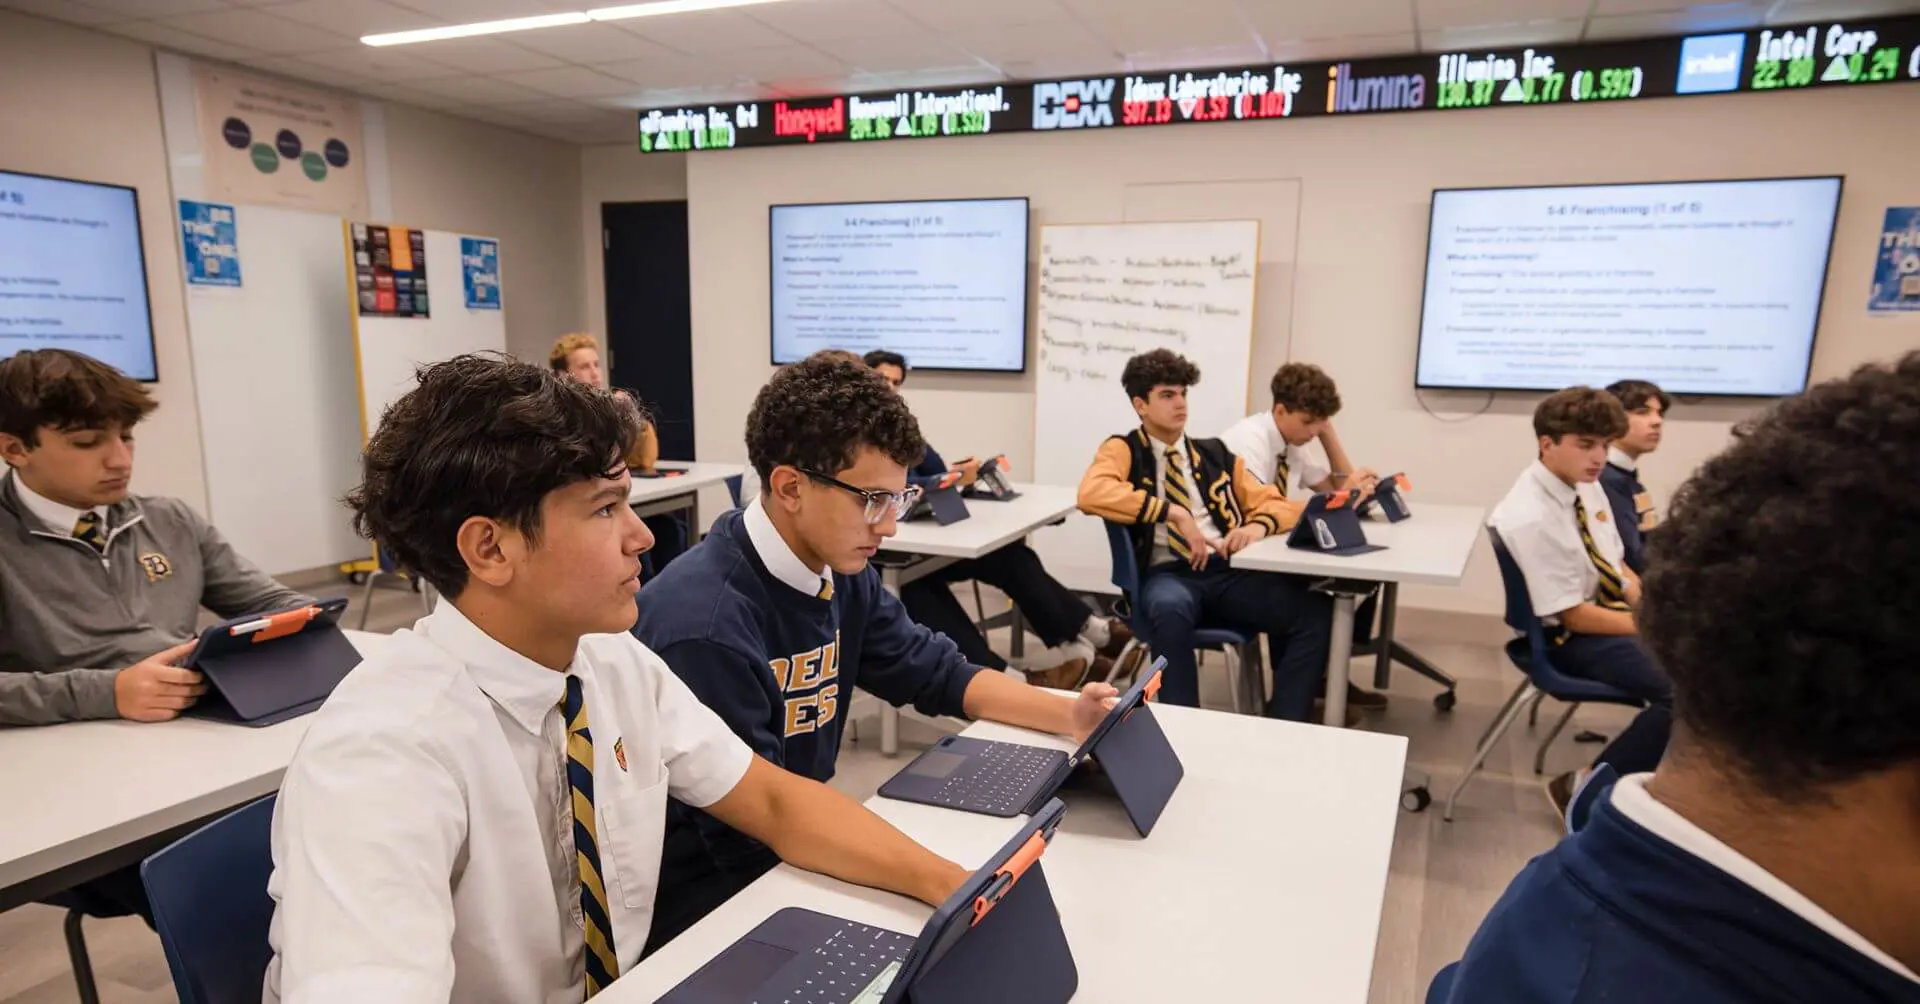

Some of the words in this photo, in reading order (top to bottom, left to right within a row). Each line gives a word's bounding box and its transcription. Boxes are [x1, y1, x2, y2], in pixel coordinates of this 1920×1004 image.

[1757, 27, 1818, 61] Intel
[1824, 24, 1878, 56] Corp
[1325, 63, 1427, 115] illumina
[1438, 53, 1516, 83] Illumina
[1522, 49, 1555, 79] Inc
[774, 97, 845, 143] Honeywell
[1032, 79, 1116, 131] IDEXX
